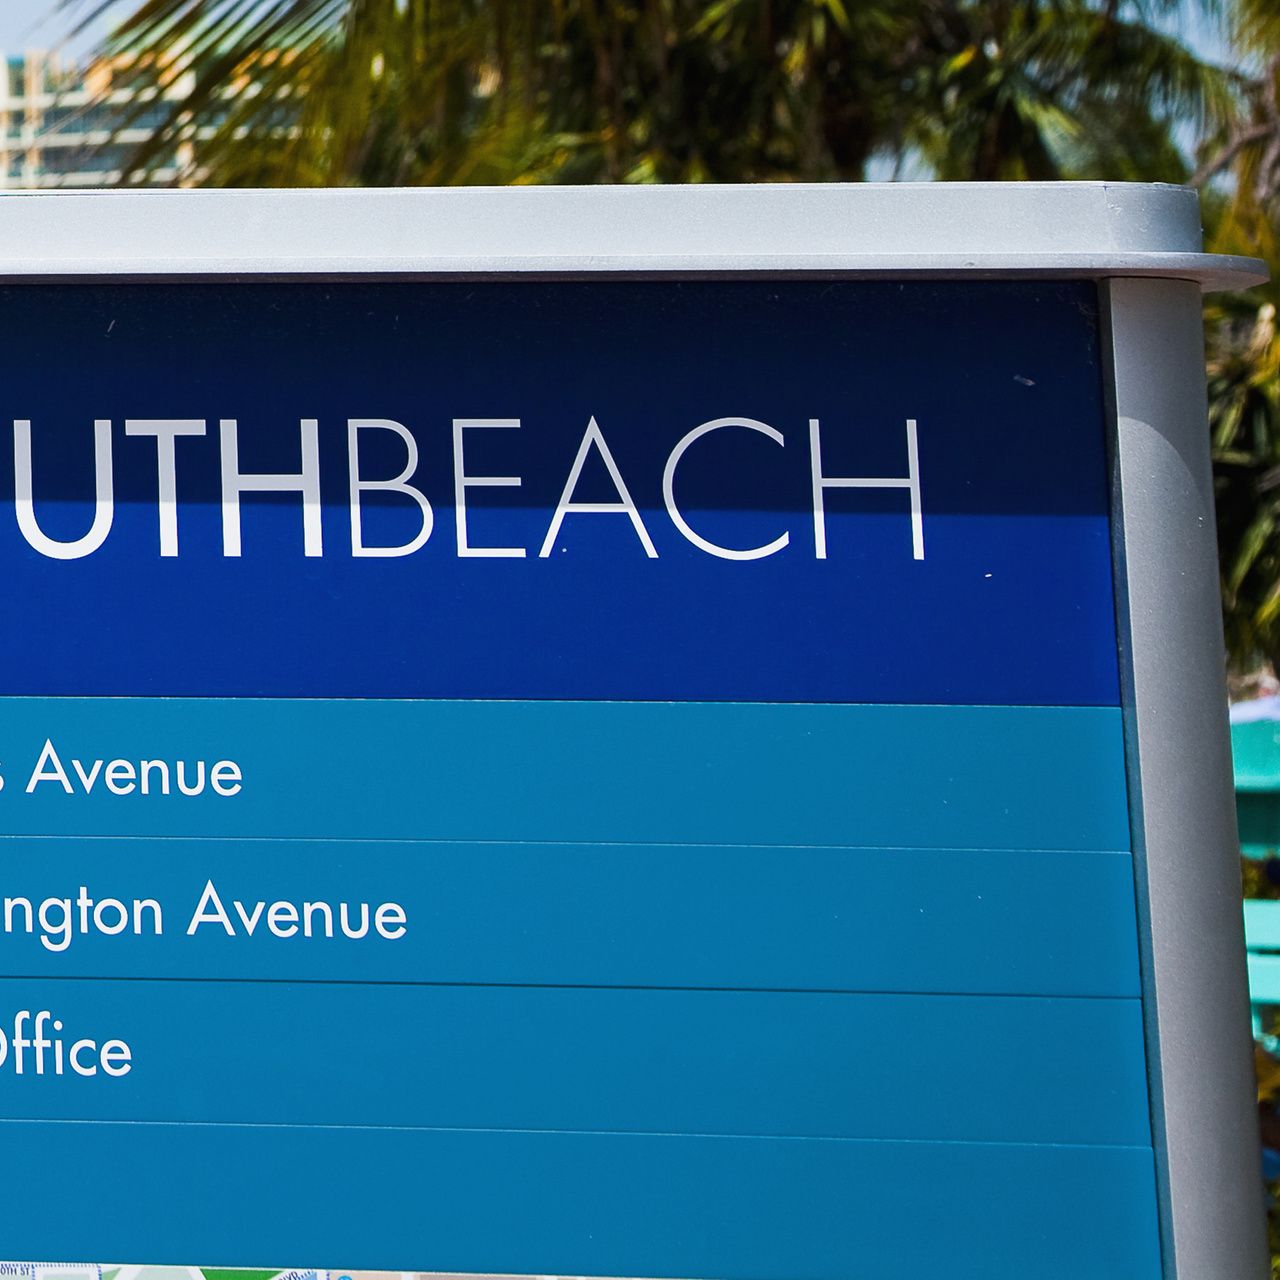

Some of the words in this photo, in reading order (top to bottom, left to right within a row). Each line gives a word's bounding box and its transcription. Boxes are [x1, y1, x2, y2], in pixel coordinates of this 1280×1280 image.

[26, 739, 242, 797] Avenue
[187, 880, 406, 939] Avenue
[20, 1267, 30, 1276] ST
